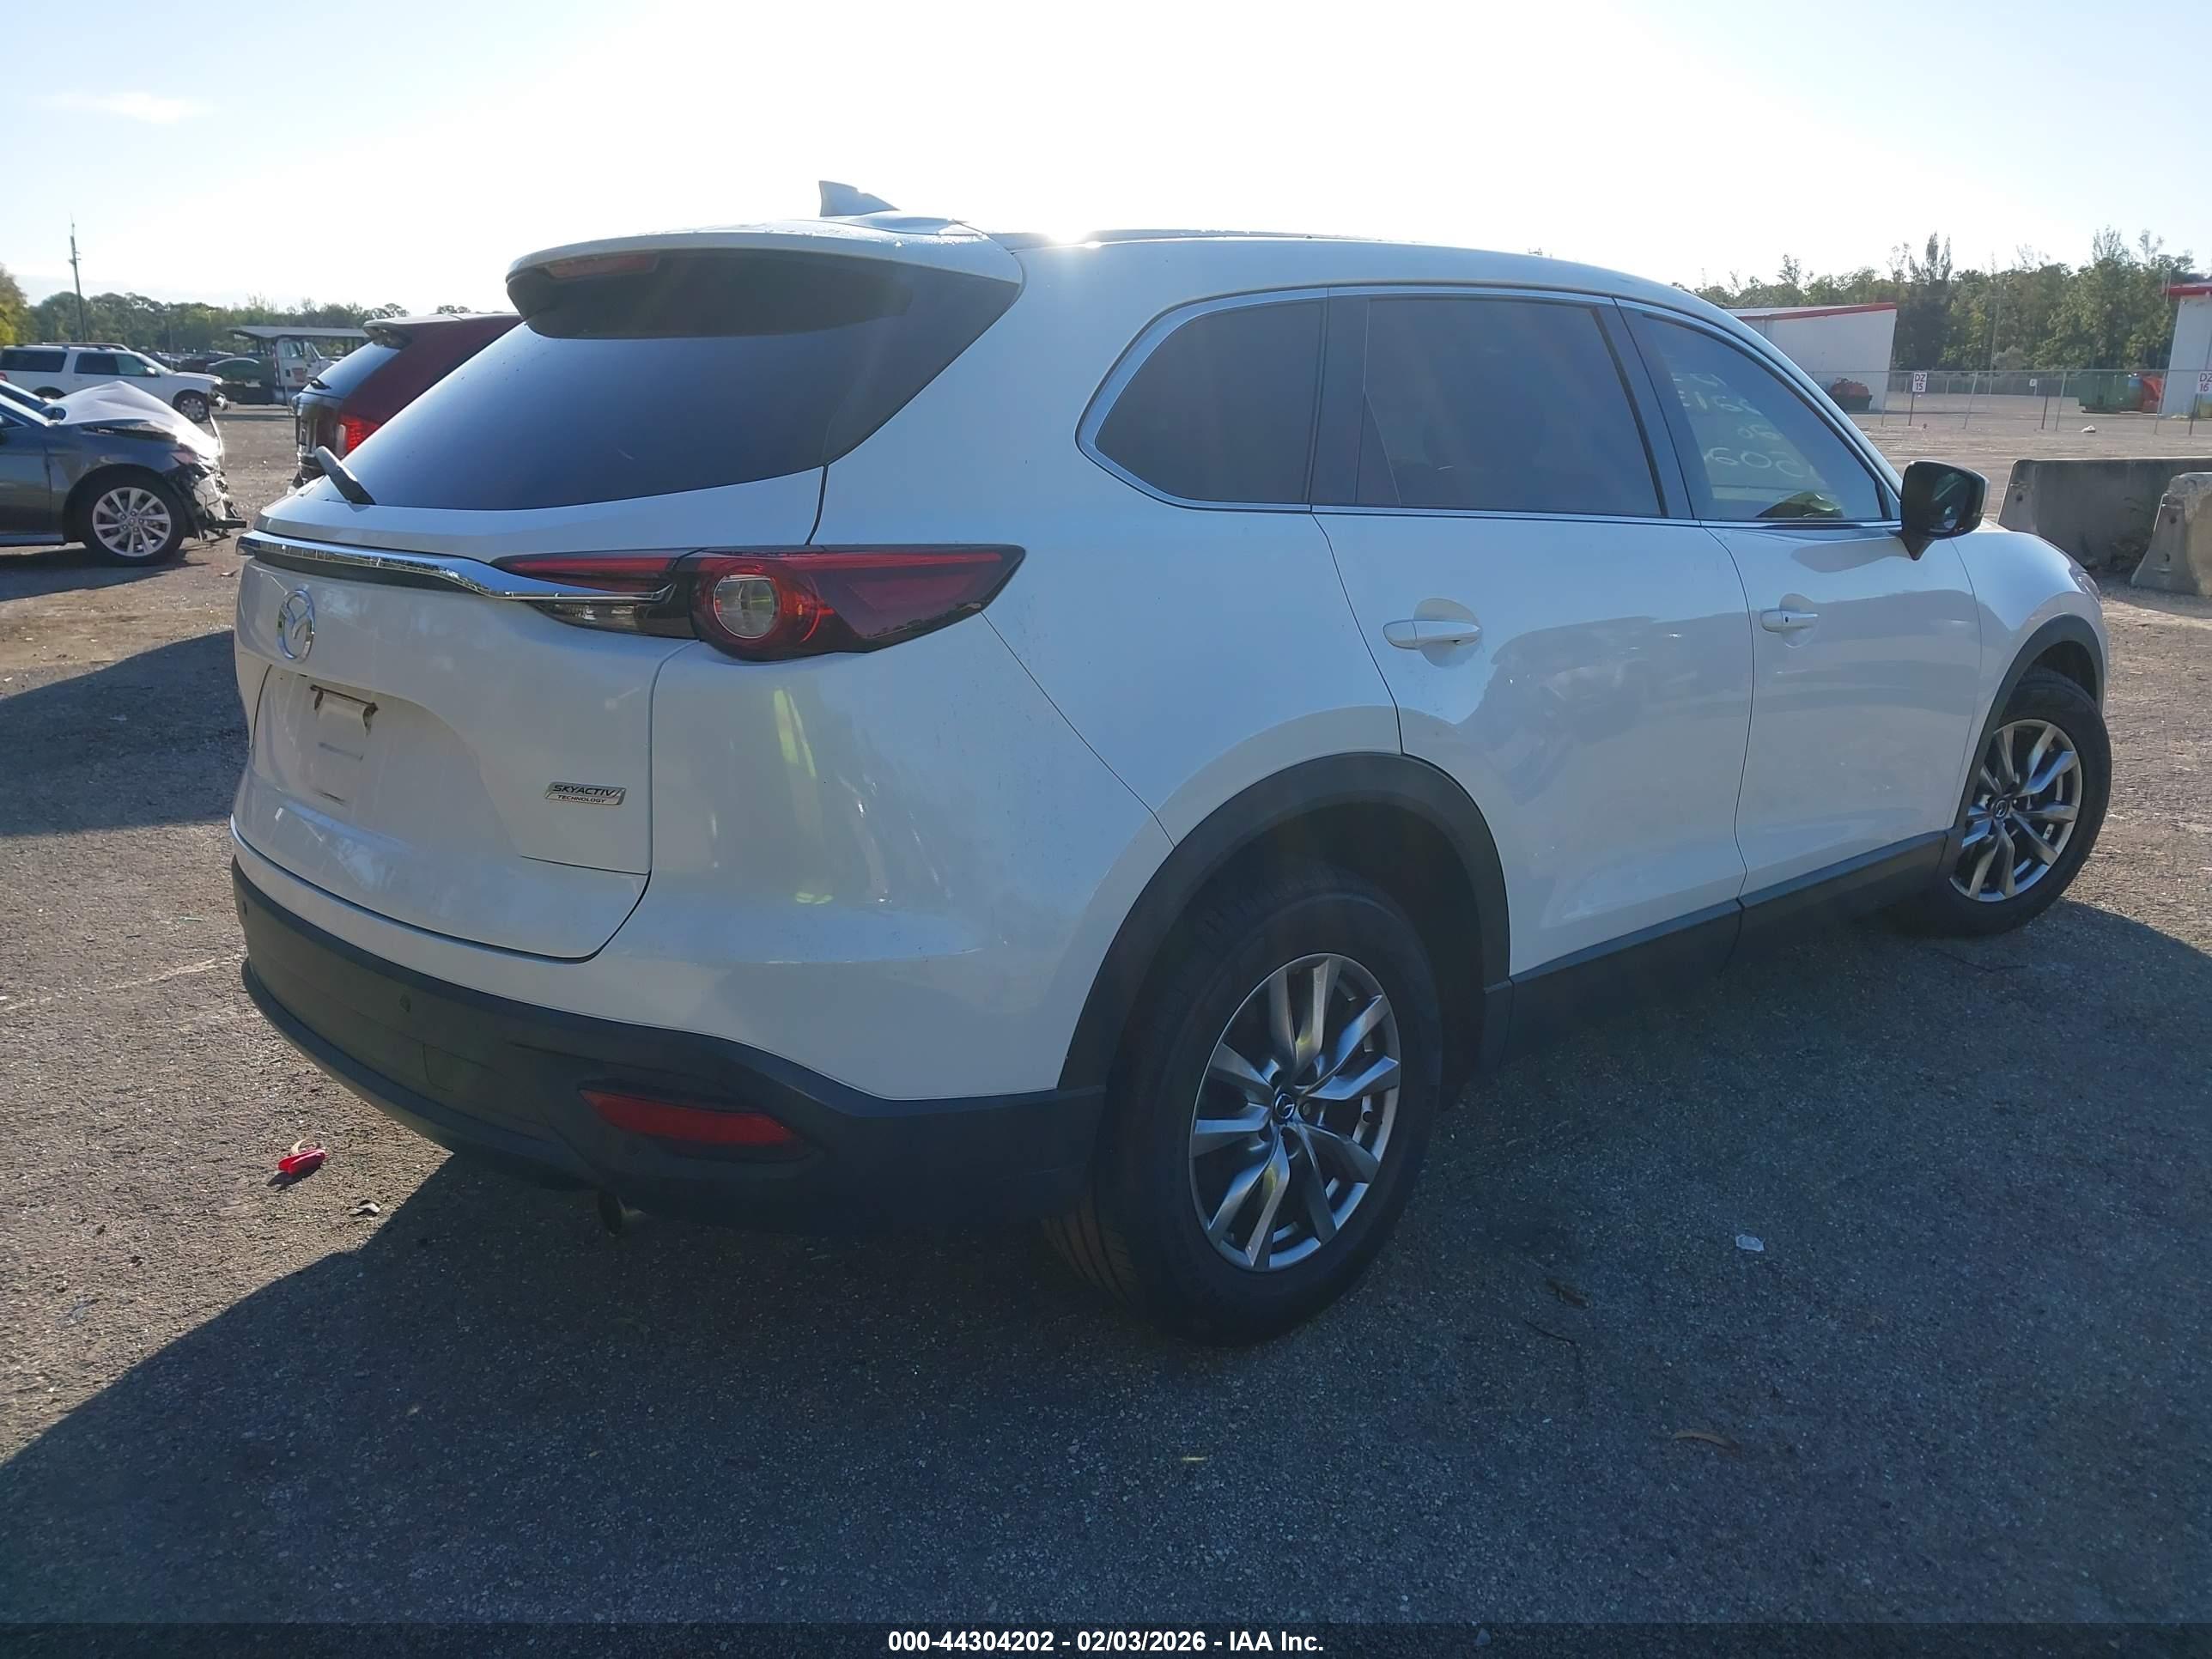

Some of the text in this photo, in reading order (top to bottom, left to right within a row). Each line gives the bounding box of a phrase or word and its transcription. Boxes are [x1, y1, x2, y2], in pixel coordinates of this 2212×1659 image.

[1915, 374, 1926, 382] DZ
[1916, 382, 1923, 391] 15
[2199, 383, 2209, 392] 16
[553, 785, 617, 798] SKYACTIV
[557, 794, 606, 803] TECHNOLOGY
